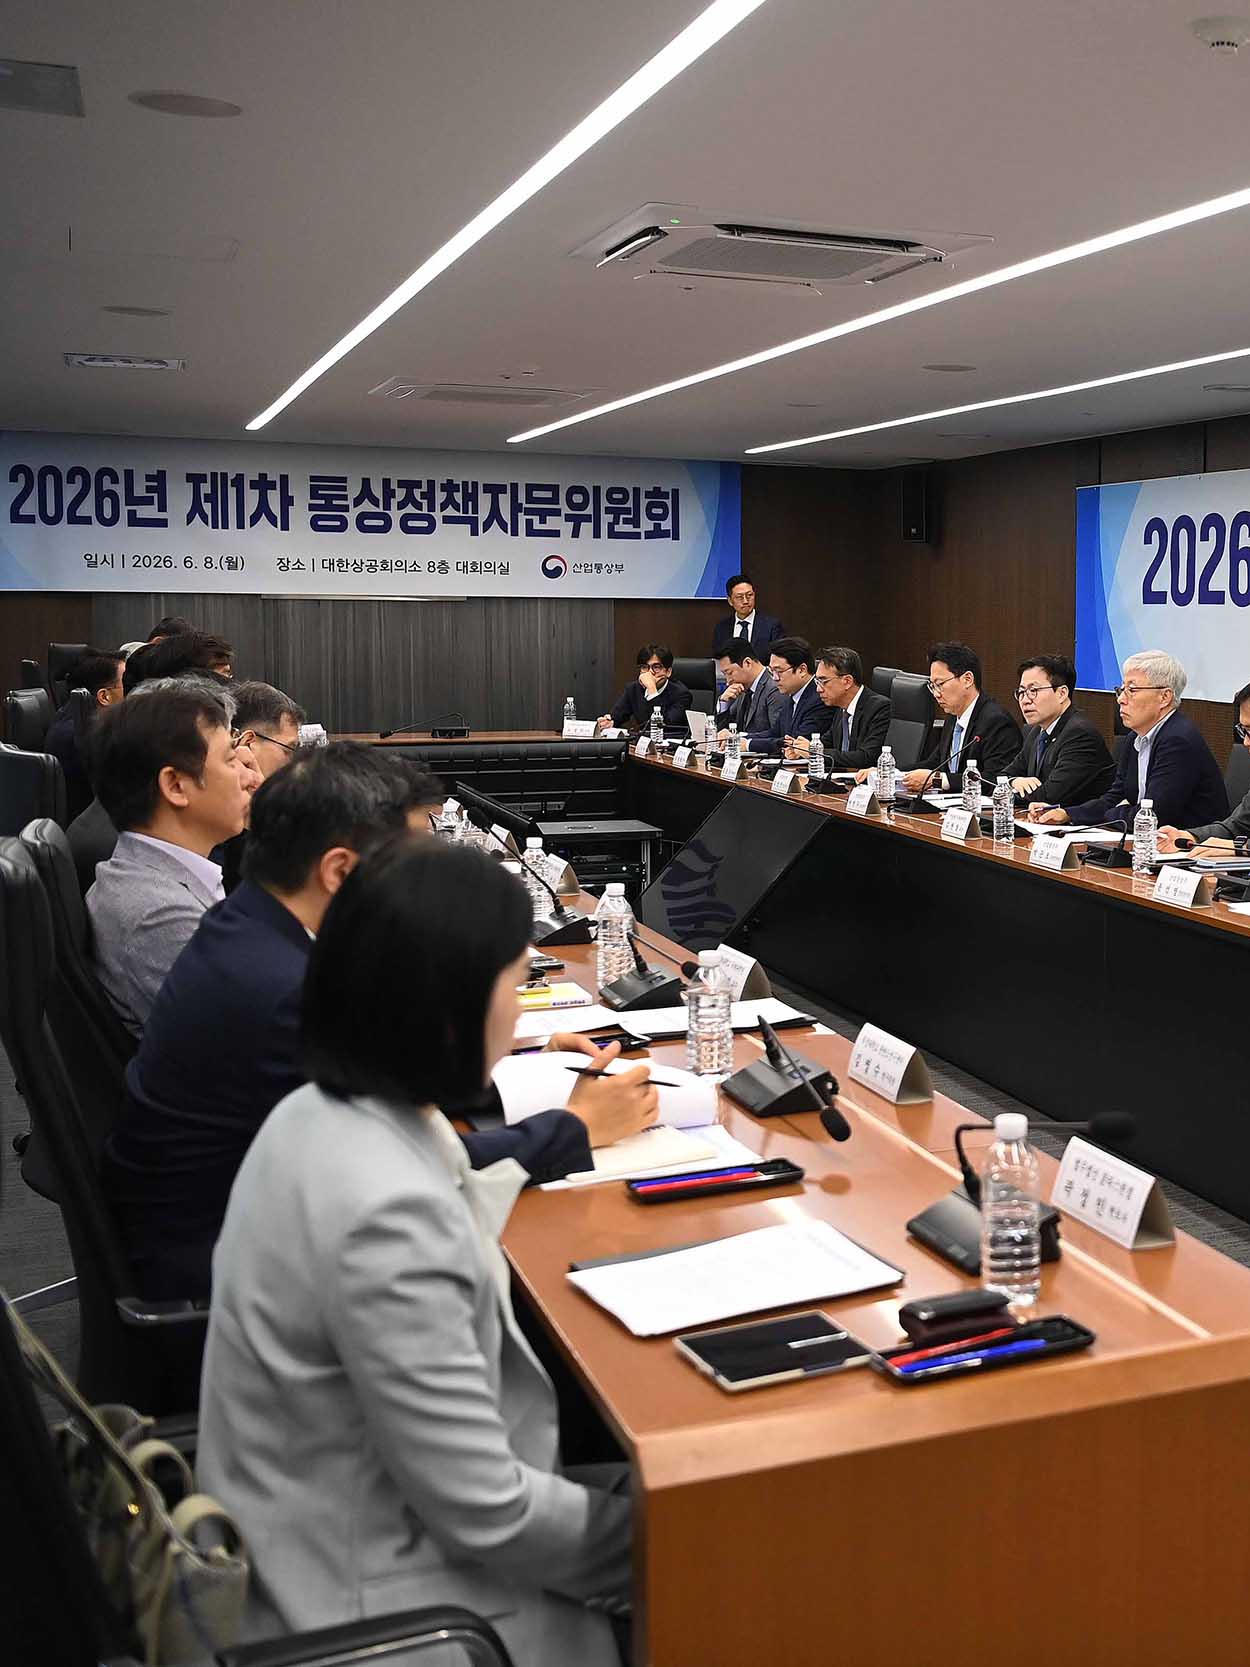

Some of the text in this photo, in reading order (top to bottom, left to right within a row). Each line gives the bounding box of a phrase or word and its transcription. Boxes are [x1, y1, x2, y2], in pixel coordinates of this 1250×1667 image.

[8, 463, 680, 541] 2026년 제1차 통상정책자문위원회
[83, 553, 114, 569] 일시
[132, 554, 177, 569] 2026.
[183, 555, 198, 569] 6.
[276, 557, 510, 576] 장소 대한상공회의소 8층 대회의실
[572, 562, 625, 575] 산업통상부
